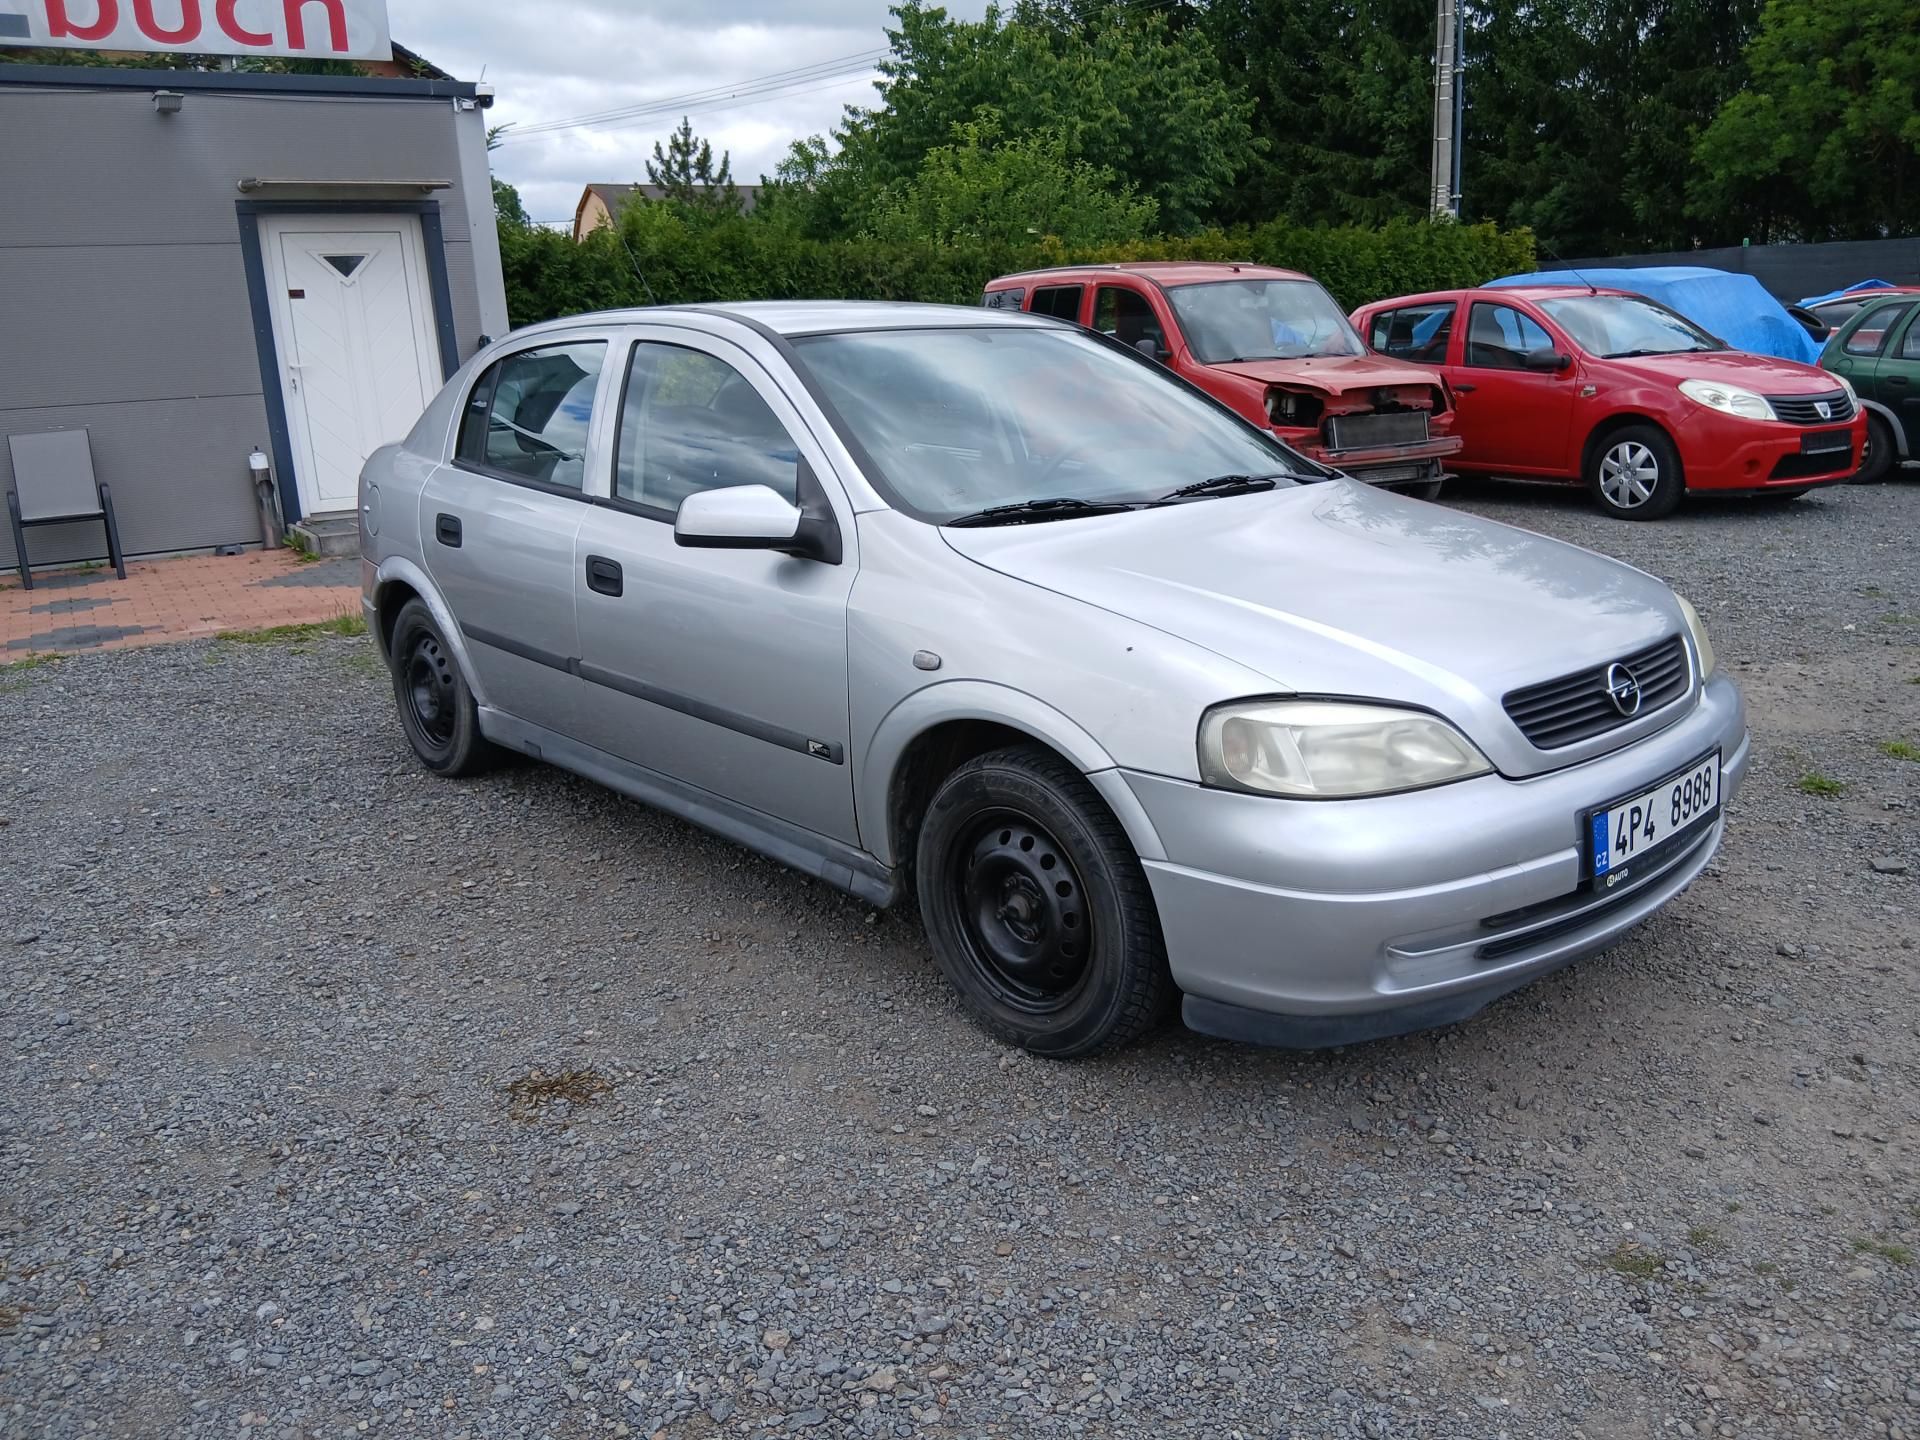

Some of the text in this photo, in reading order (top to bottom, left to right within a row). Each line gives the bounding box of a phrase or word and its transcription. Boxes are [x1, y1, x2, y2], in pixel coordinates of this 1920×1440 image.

[1615, 799, 1655, 856] 4P4
[1671, 766, 1712, 827] 8988
[1595, 851, 1608, 868] CZ
[1615, 868, 1629, 883] AUTO
